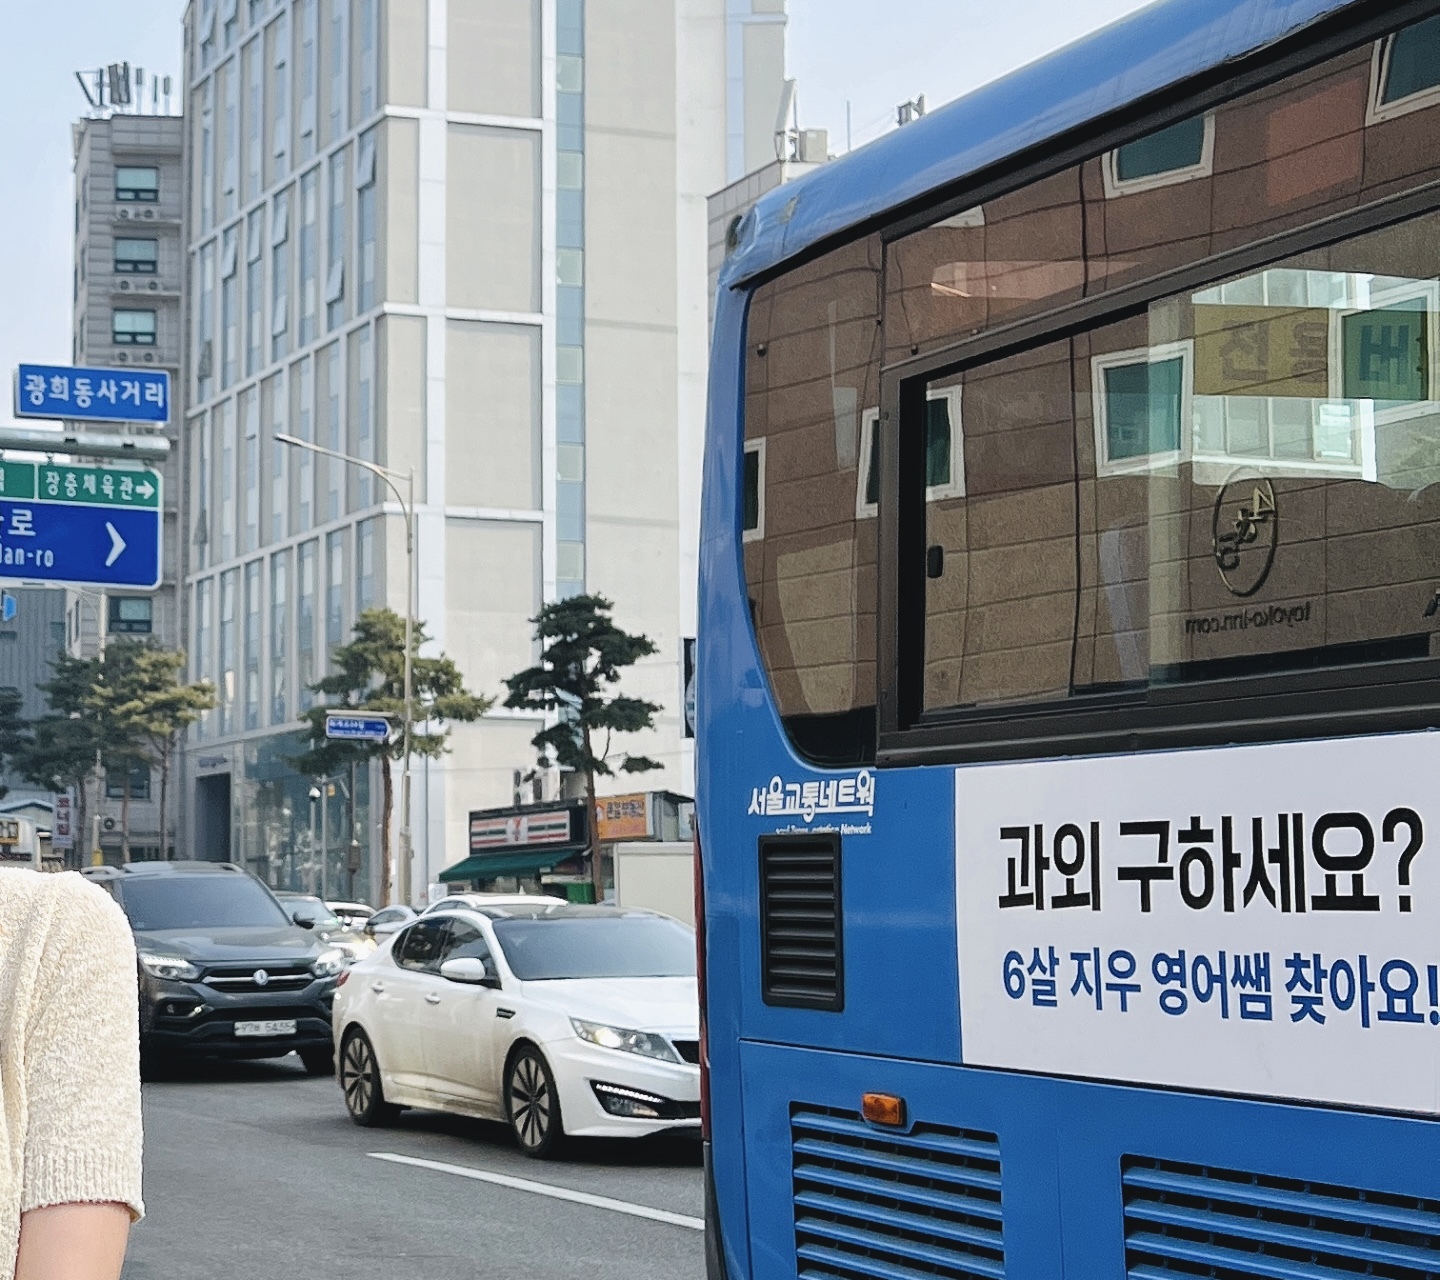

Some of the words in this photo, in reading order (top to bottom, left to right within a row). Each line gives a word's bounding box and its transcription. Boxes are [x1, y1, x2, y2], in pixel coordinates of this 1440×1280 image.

[23, 373, 164, 408] 광희동사거리
[45, 471, 134, 501] 장충체육관
[747, 770, 876, 823] 서울교통네트웍
[840, 822, 873, 836] Network
[998, 821, 1101, 912] 과외
[1117, 806, 1424, 913] 구하세요?
[1002, 945, 1060, 1008] 6살
[1069, 946, 1142, 1013] 지우
[1151, 948, 1273, 1022] 영어쌤
[1284, 951, 1440, 1029] 찾아요!
